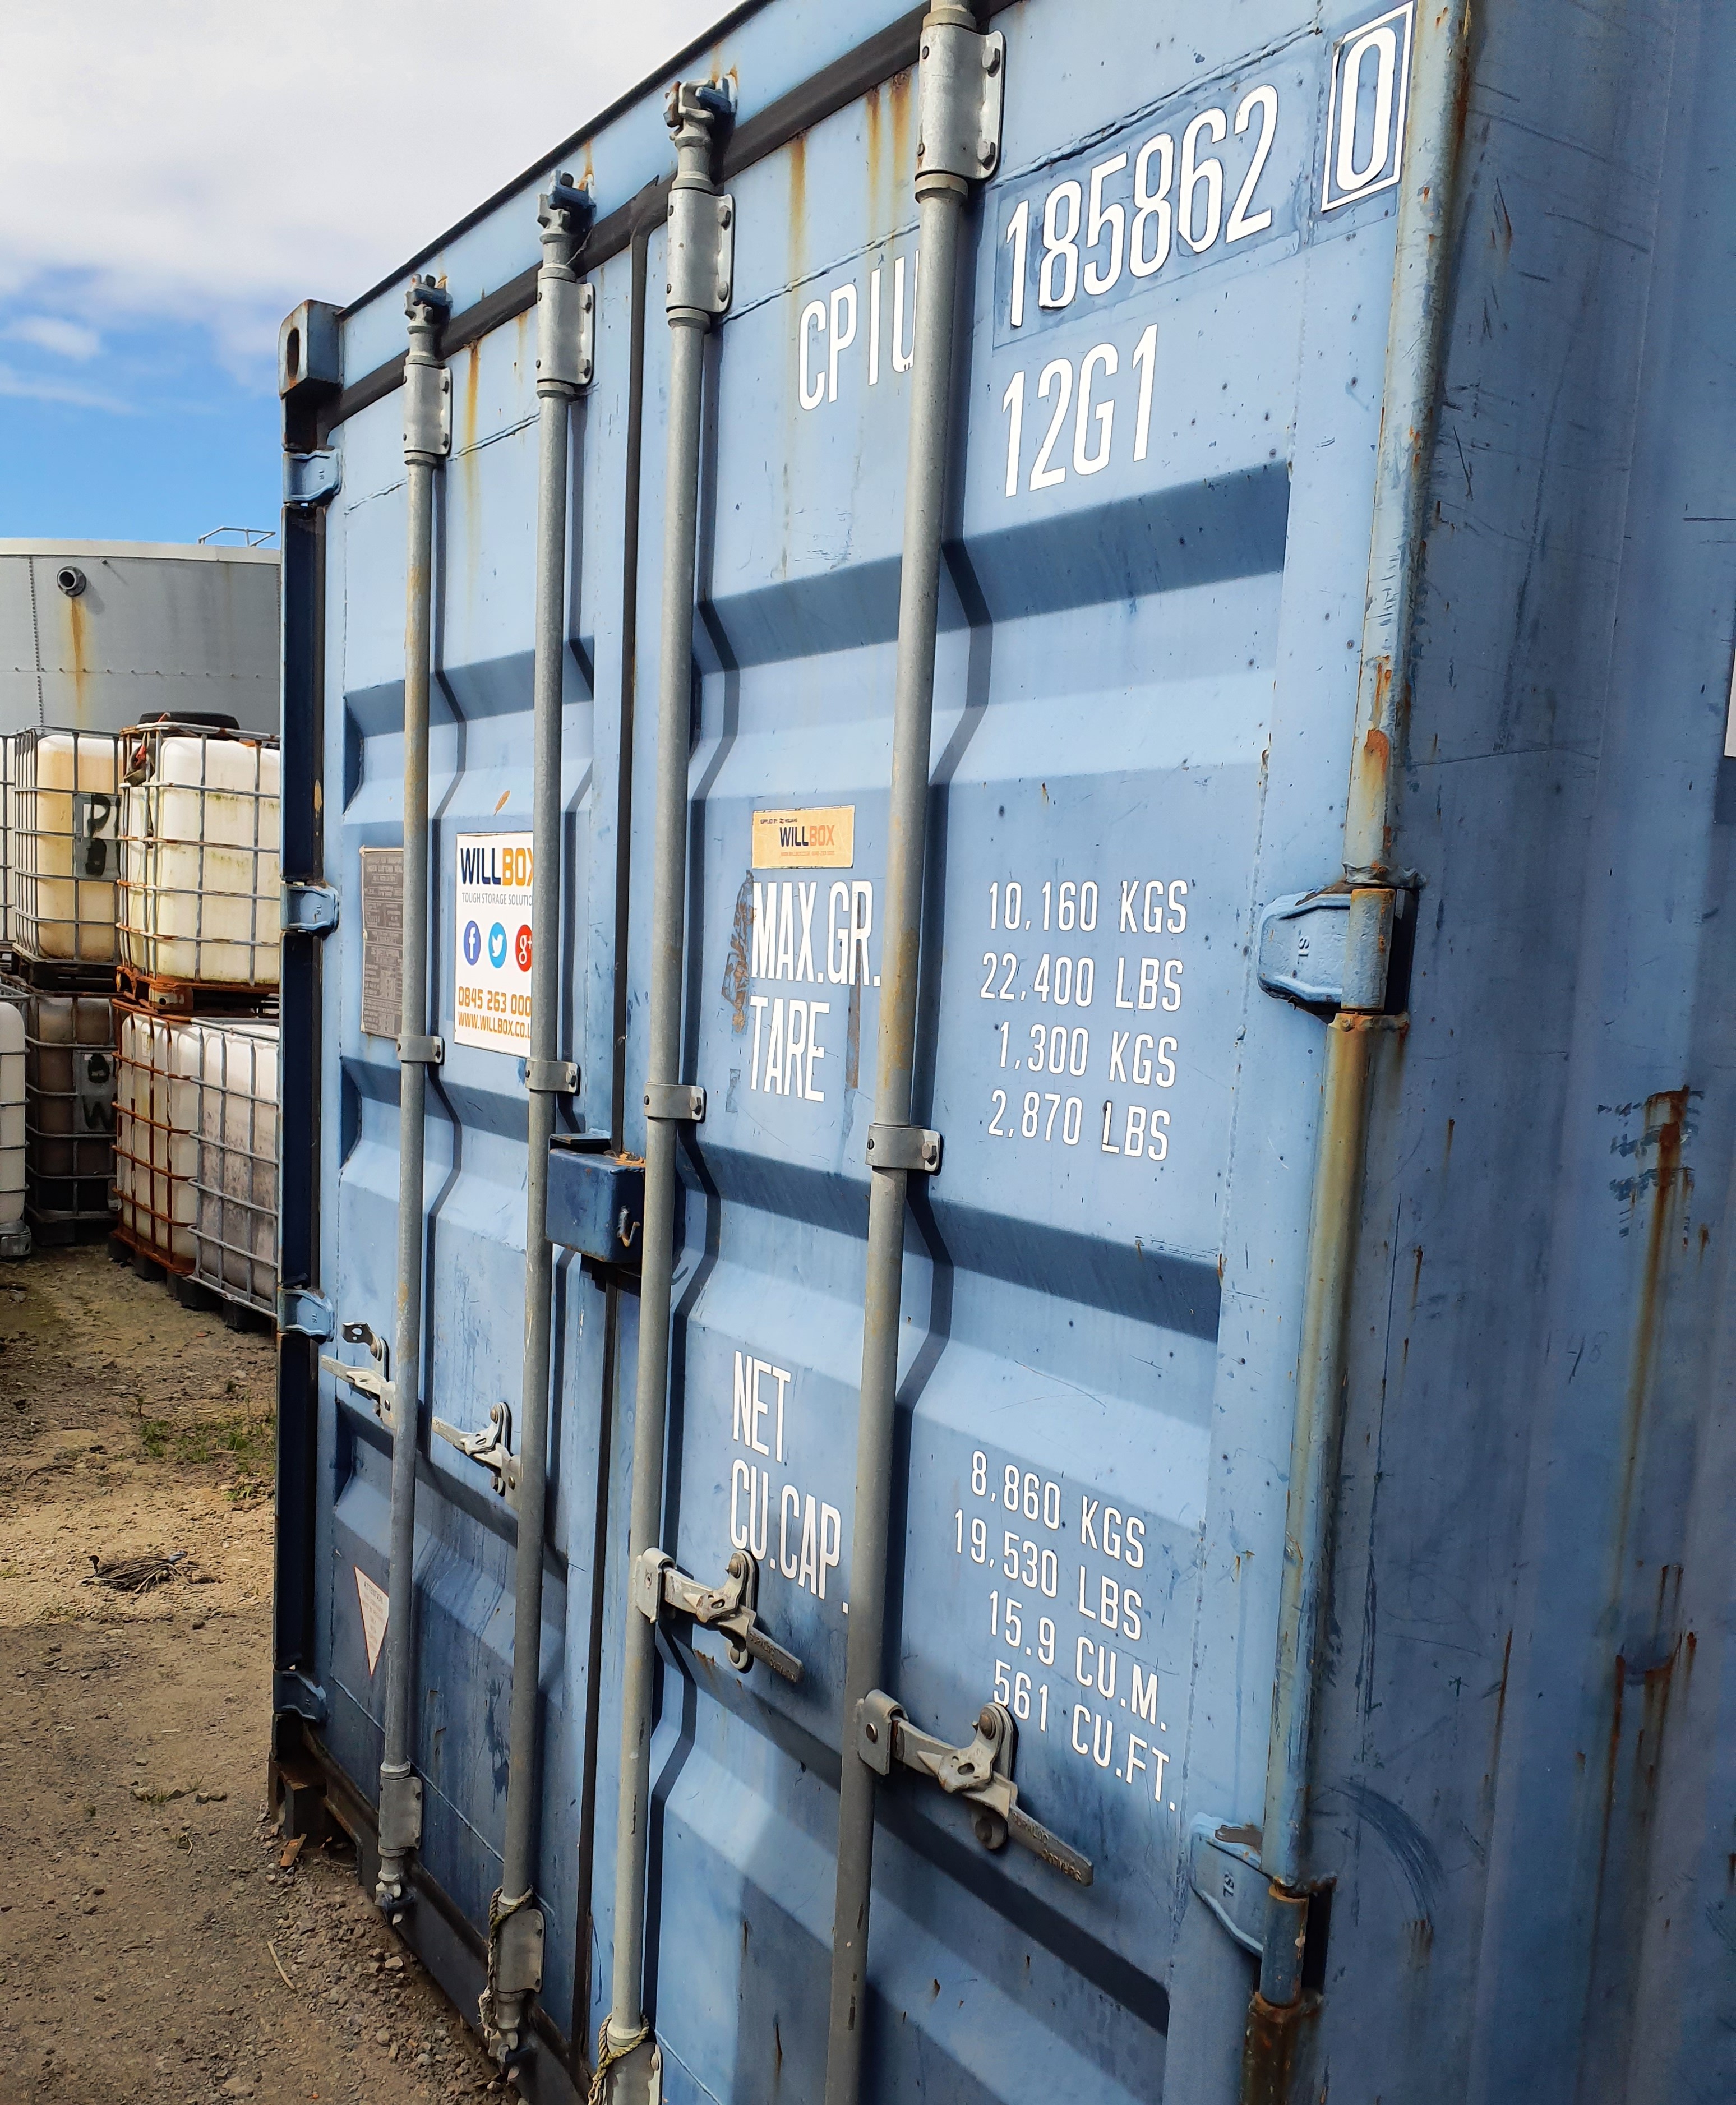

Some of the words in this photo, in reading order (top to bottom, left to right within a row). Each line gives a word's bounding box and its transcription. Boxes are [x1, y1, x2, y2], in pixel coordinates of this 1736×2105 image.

[799, 249, 920, 411] CPIU
[1006, 83, 1278, 327] 185862
[1336, 26, 1396, 191] 0
[1001, 323, 1158, 498] 12G1
[779, 825, 835, 847] WILLBOX
[461, 892, 481, 903] TOUGH
[482, 893, 507, 905] STORAGE
[750, 881, 880, 987] MAX.GR.
[989, 881, 1098, 931] 10,160
[1120, 880, 1188, 933] KGS
[458, 986, 483, 1009] 0845
[487, 990, 507, 1013] 263
[980, 952, 1095, 1007] 22,400
[1115, 957, 1184, 1012] LBS
[750, 995, 830, 1102] TARE
[999, 1021, 1089, 1077] 1,300
[1109, 1031, 1178, 1087] KGS
[988, 1090, 1083, 1145] 2,870
[1101, 1101, 1171, 1161] LBS
[732, 1350, 791, 1463] NET
[971, 1450, 1061, 1530] 8,860
[1080, 1494, 1146, 1569] KGS
[955, 1508, 1059, 1598] 19,530
[1078, 1564, 1143, 1641] LBS
[989, 1590, 1056, 1666] 15.9
[1075, 1636, 1167, 1731] CU.M.
[993, 1659, 1049, 1732] 561
[1071, 1704, 1176, 1812] CU.FT.
